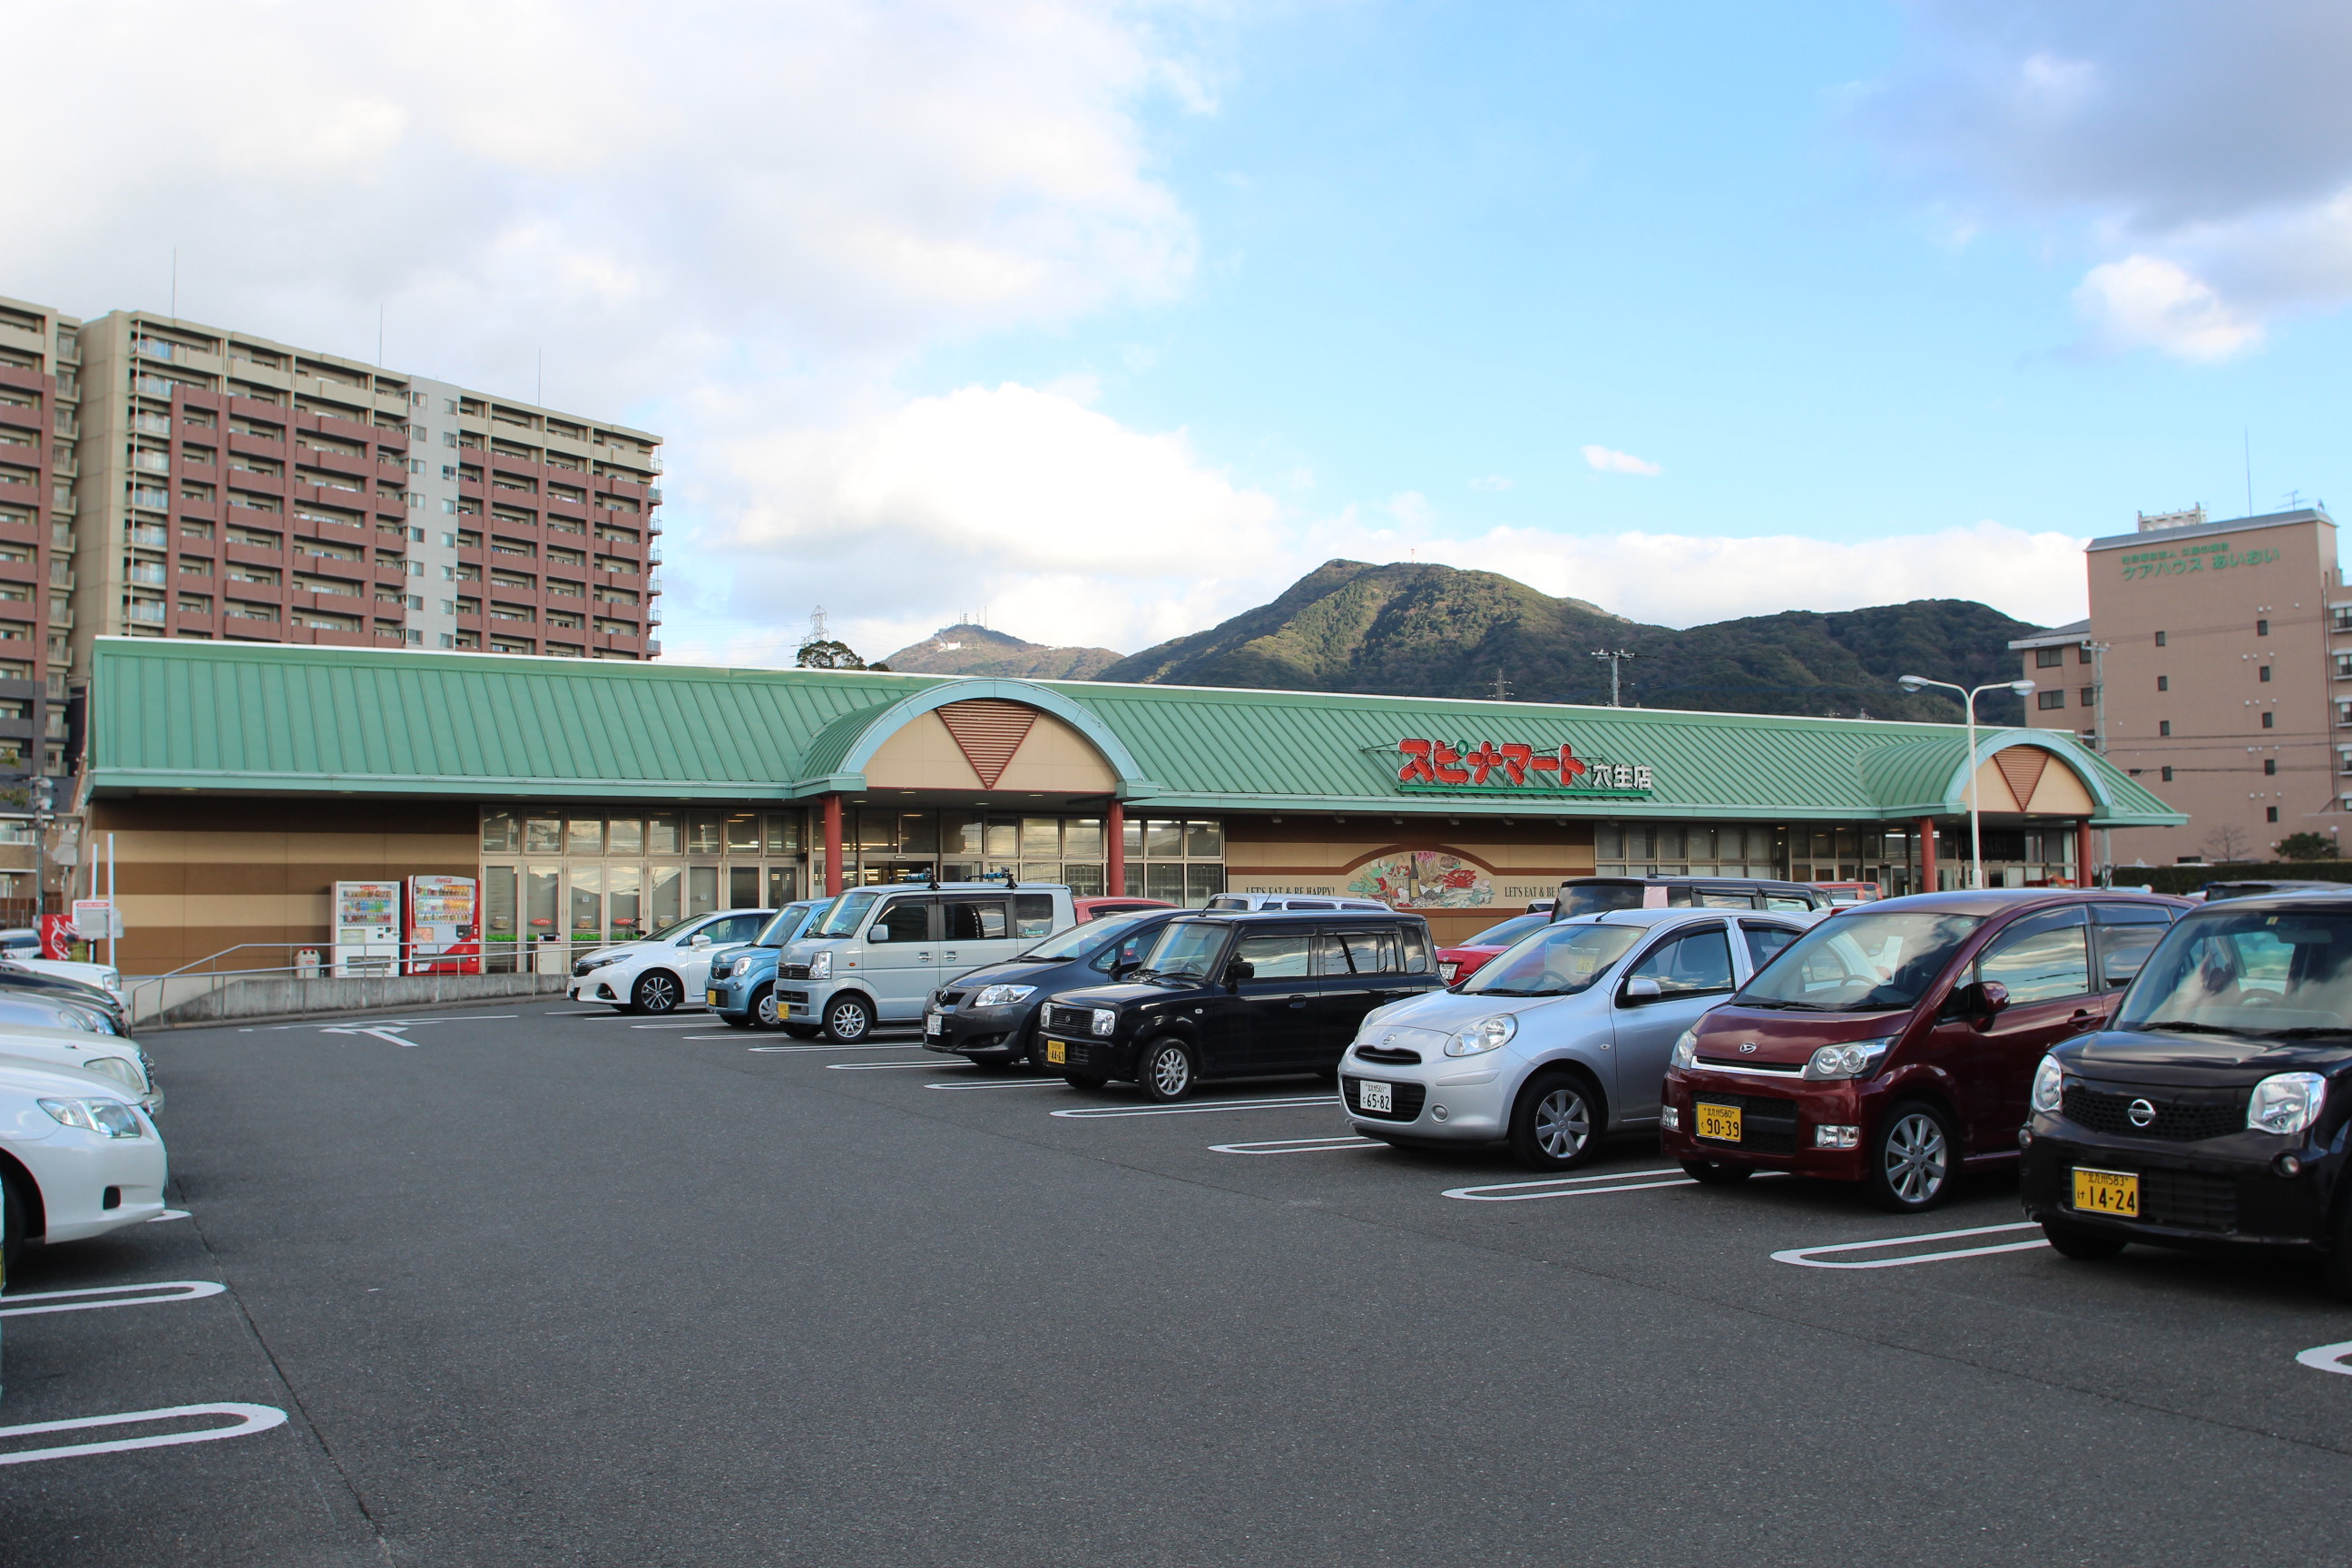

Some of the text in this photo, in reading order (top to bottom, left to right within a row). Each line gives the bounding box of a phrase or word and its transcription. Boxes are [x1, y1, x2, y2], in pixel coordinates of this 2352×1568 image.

[2122, 556, 2204, 581] ケアハウス
[2212, 547, 2280, 570] あいおい
[1397, 738, 1652, 789] スピナマート 穴生店
[1504, 887, 1523, 897] LET'S
[1524, 887, 1537, 897] EAT
[1539, 887, 1544, 897] &
[1547, 887, 1555, 897] BE
[1707, 1118, 1740, 1137] 90-39
[2090, 1185, 2135, 1211] 14-24
